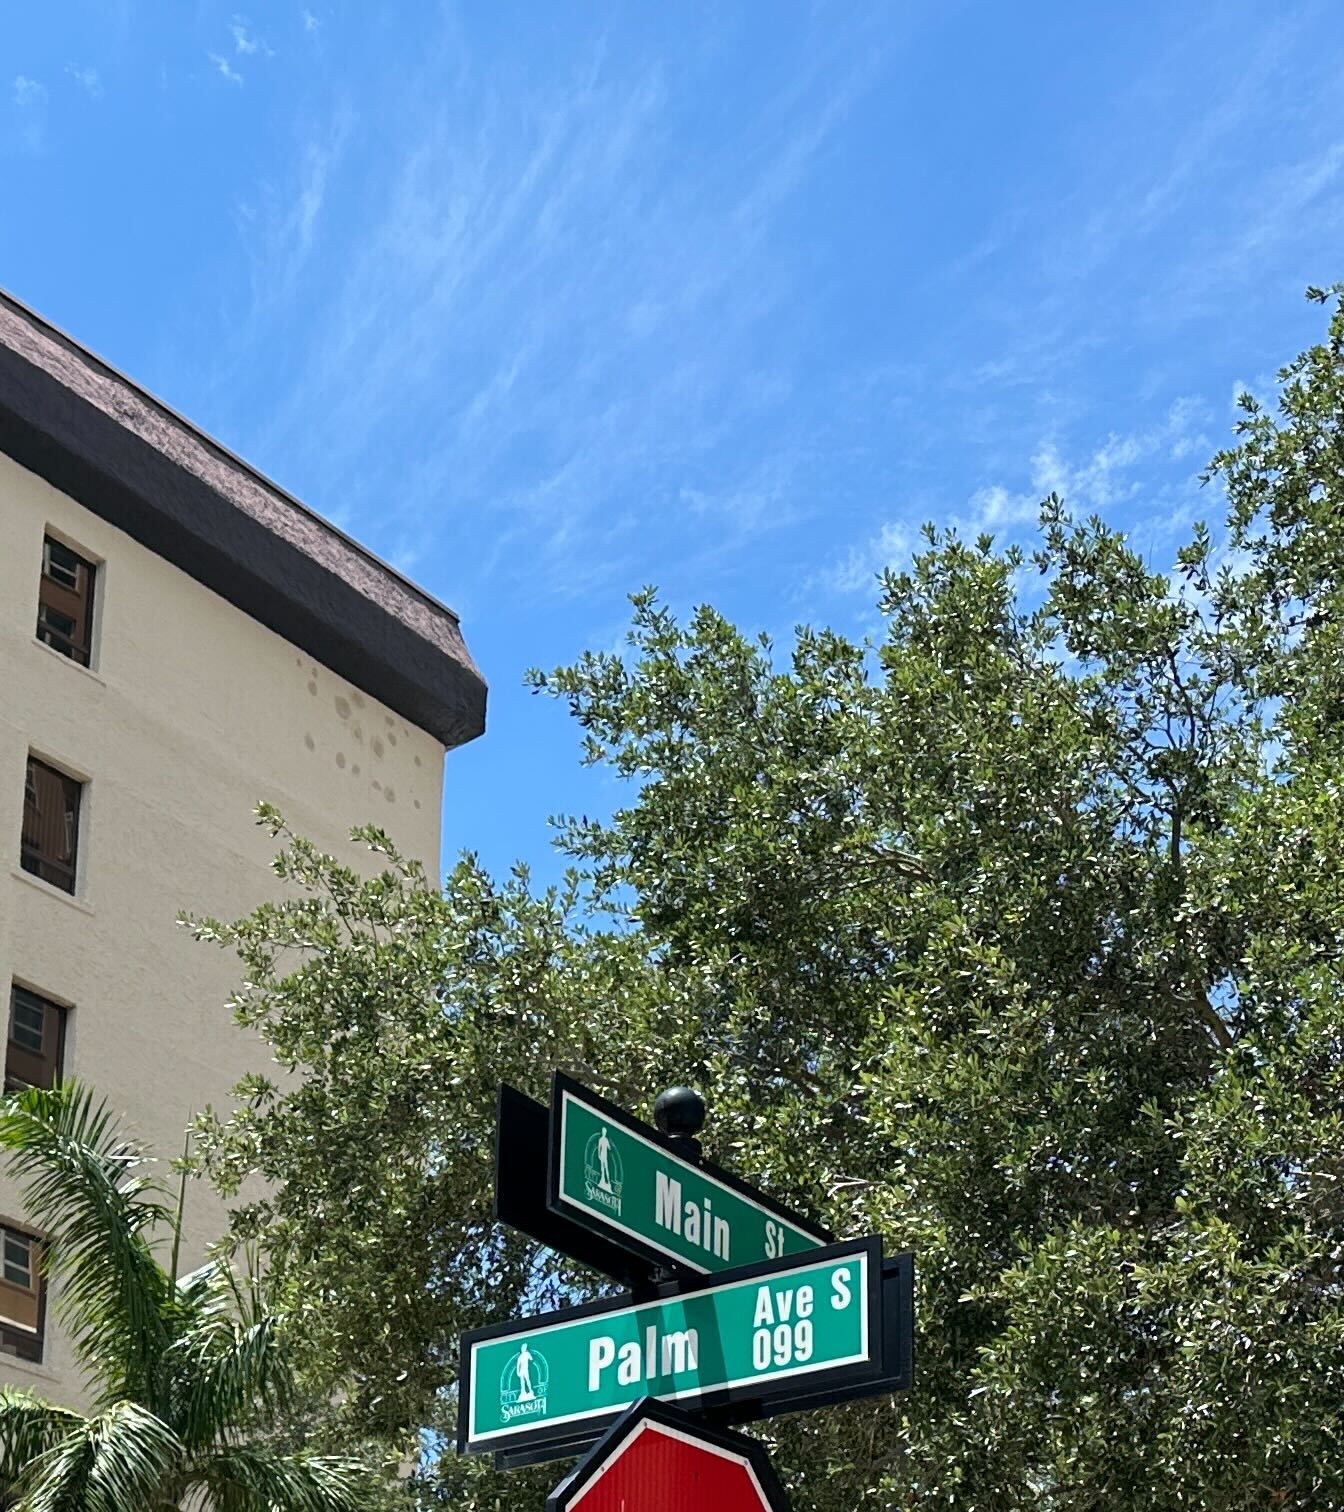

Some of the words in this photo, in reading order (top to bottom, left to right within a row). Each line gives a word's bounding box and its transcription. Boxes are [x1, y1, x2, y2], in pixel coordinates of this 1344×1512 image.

[655, 1170, 730, 1262] Main
[765, 1220, 785, 1259] St
[753, 1283, 814, 1328] Ave
[830, 1267, 852, 1310] S
[588, 1325, 698, 1392] Palm
[752, 1319, 814, 1372] 099
